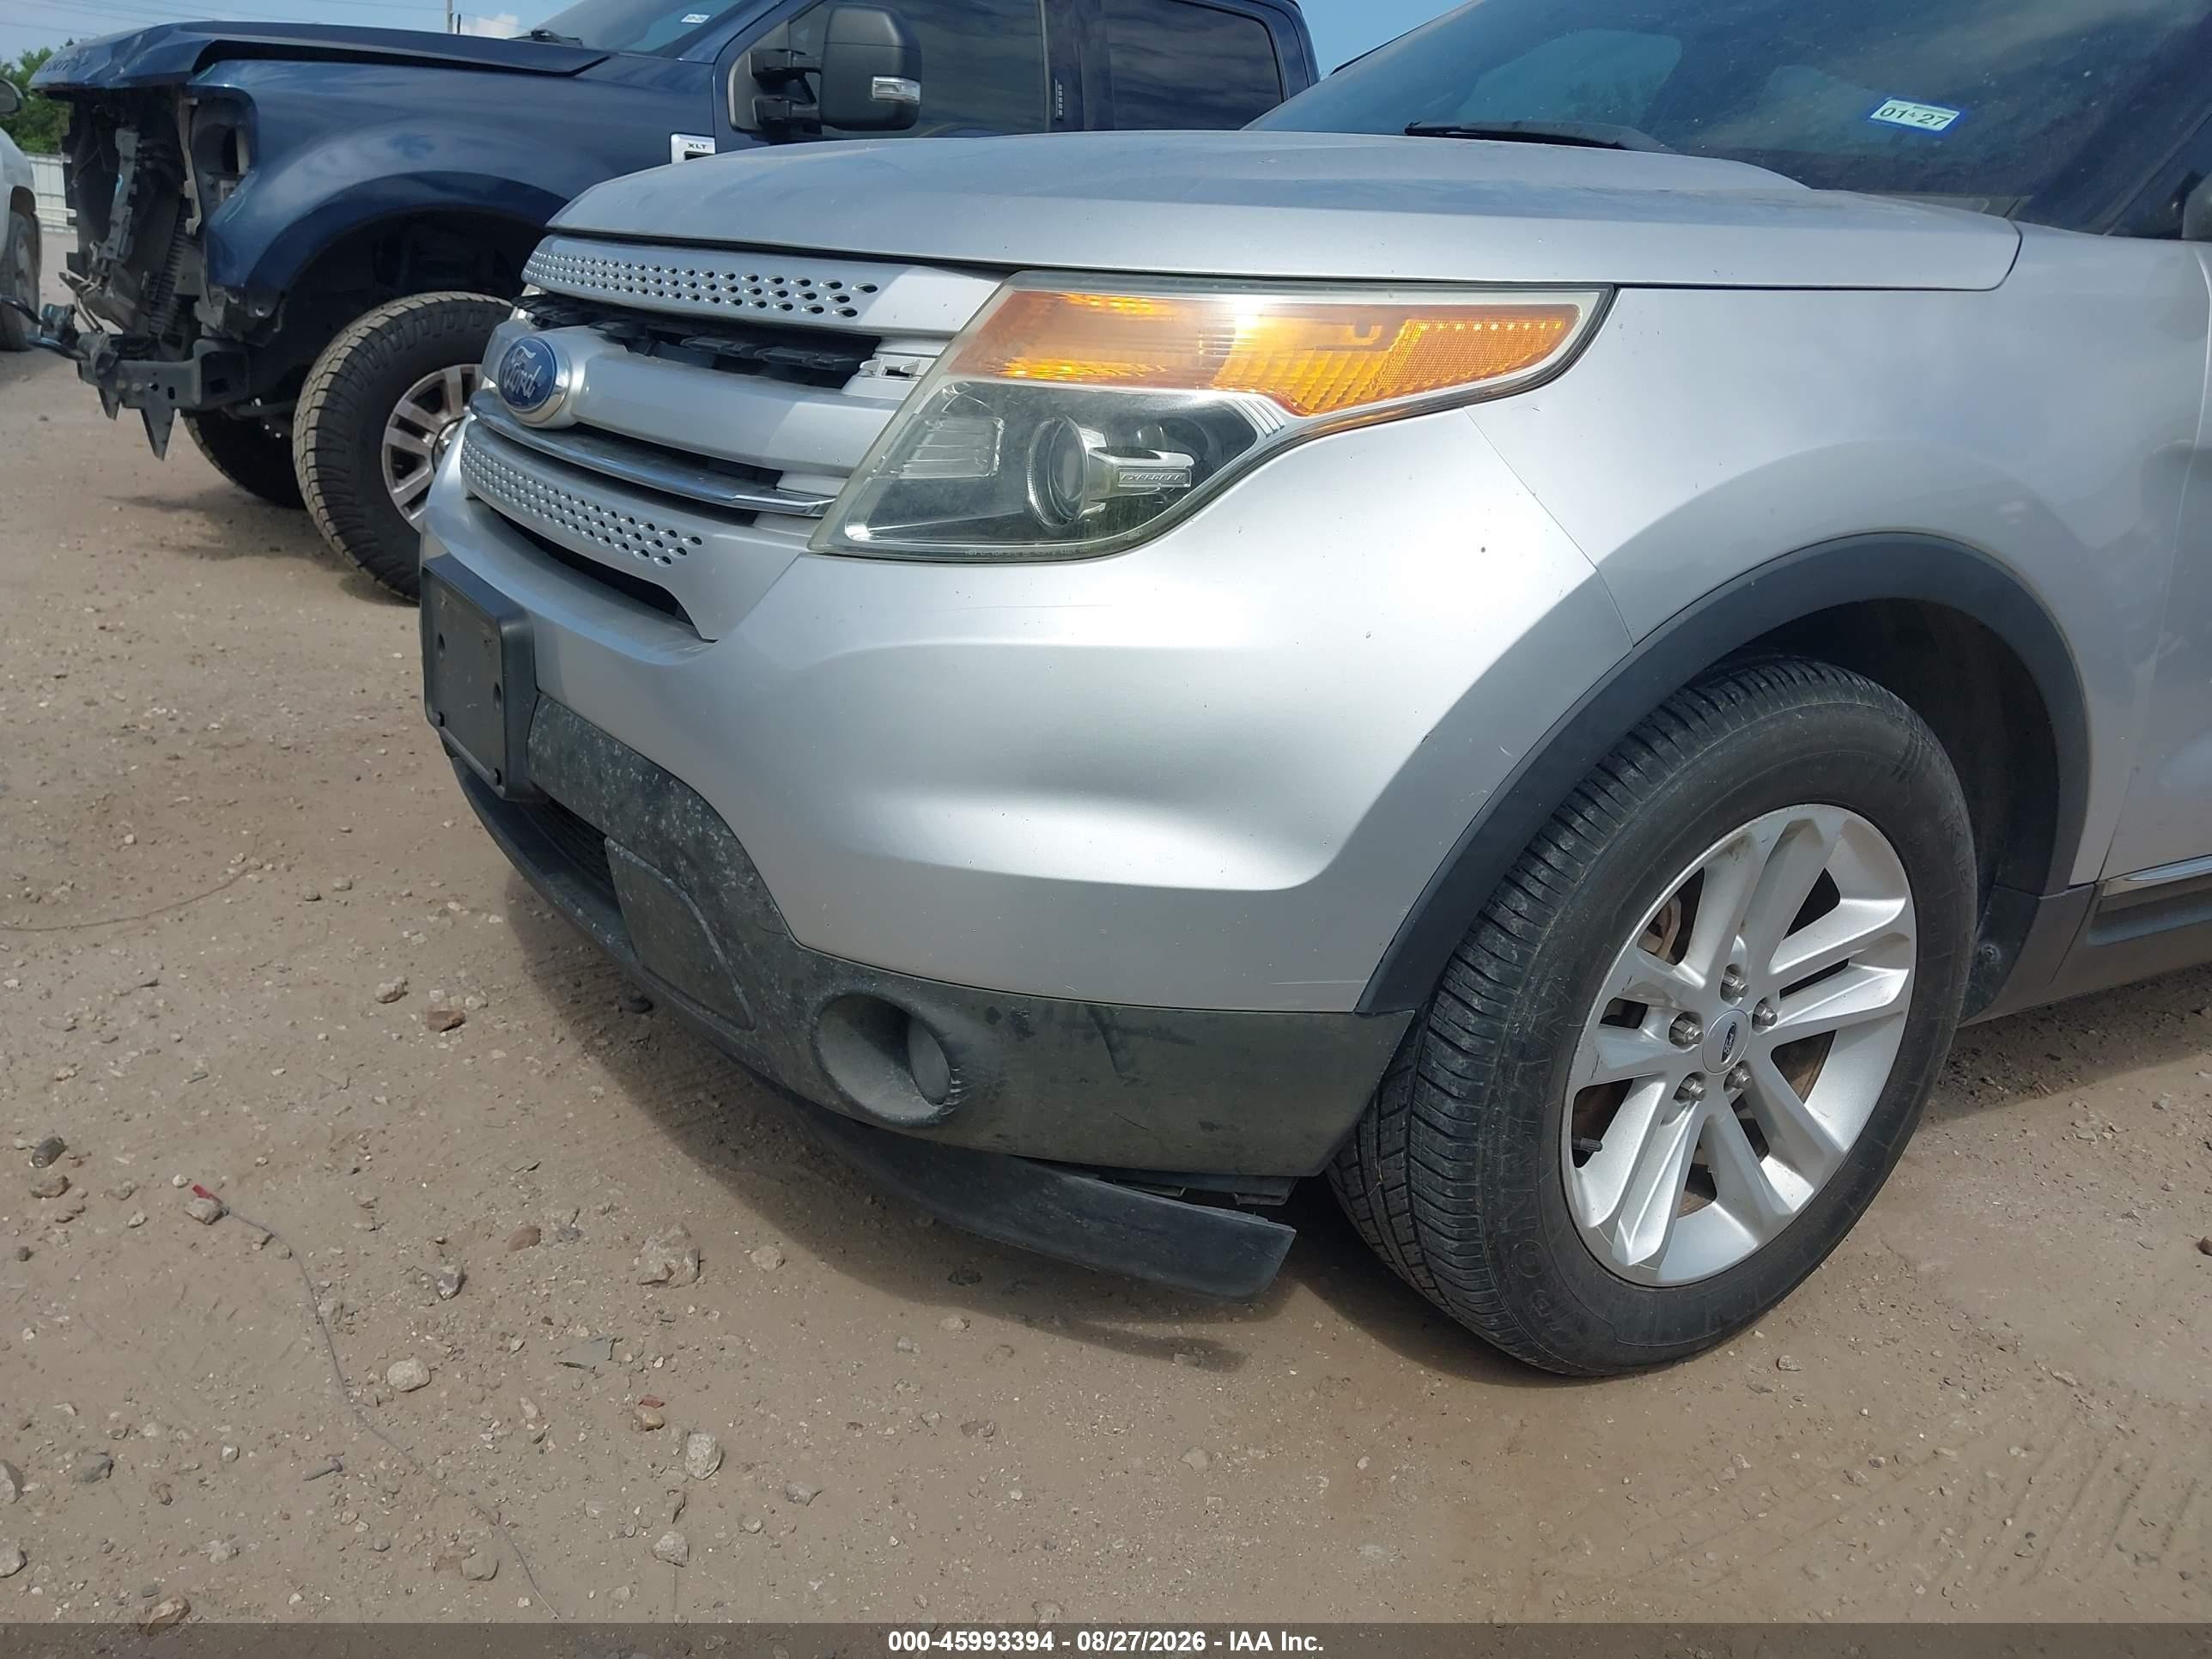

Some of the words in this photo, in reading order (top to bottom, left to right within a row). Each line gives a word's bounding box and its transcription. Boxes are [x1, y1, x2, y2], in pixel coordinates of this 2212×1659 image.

[1880, 107, 1909, 119] 01
[1916, 113, 1951, 126] 27
[502, 345, 543, 398] Ford
